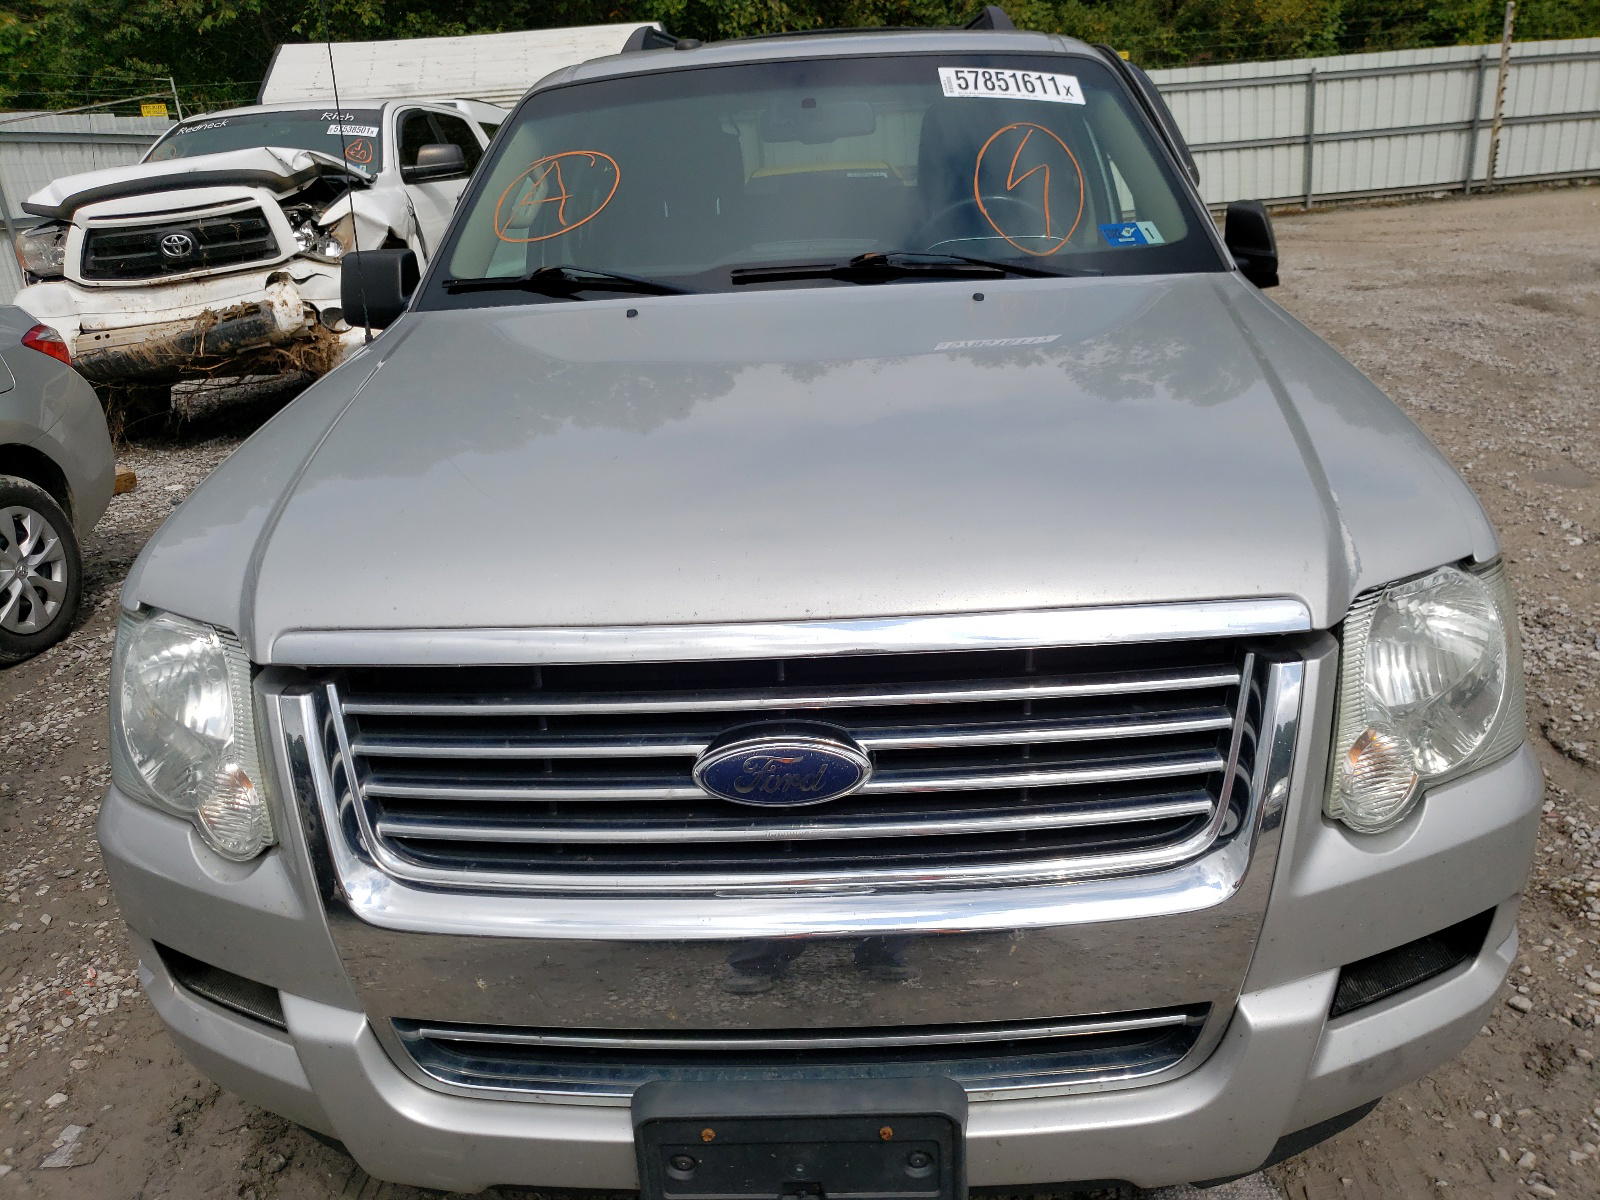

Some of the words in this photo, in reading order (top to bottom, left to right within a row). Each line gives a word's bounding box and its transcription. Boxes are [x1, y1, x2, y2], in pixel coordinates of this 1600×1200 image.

[320, 112, 354, 121] Rich
[176, 119, 229, 136] Redneck
[733, 754, 828, 794] Ford
